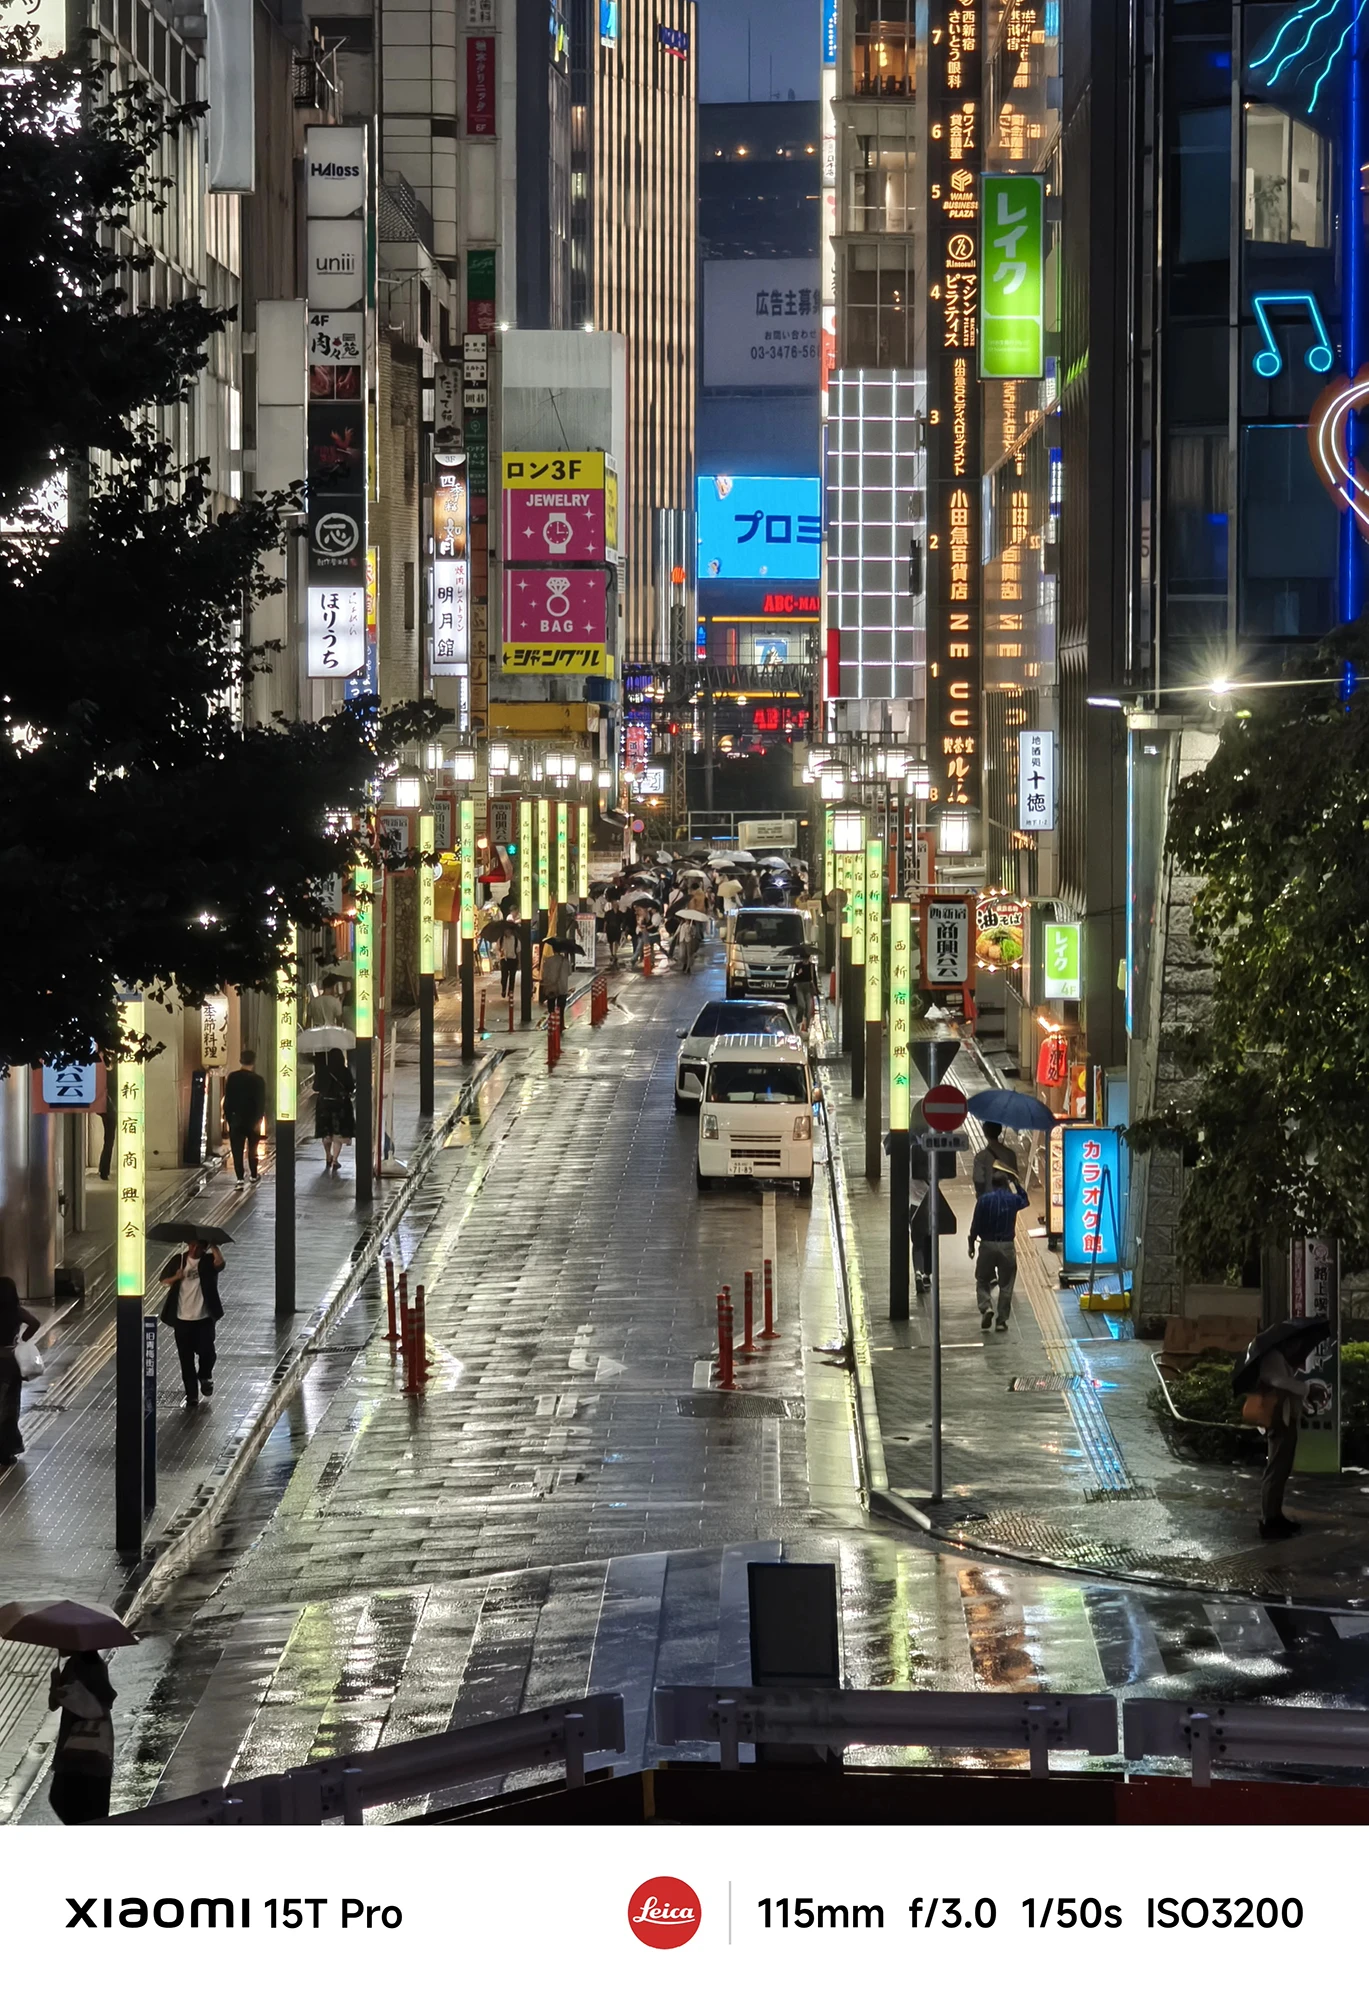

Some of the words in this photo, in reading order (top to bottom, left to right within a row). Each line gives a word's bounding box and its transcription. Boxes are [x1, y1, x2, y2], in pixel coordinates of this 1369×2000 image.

[932, 30, 942, 45] 7
[962, 10, 976, 50] 西新宿
[948, 10, 961, 88] さいとう眼科
[931, 124, 942, 139] 6
[963, 115, 975, 149] ワイム
[311, 163, 359, 177] HAloss
[931, 184, 941, 199] 5
[950, 192, 973, 201] WAIM
[949, 209, 974, 218] PLAZA
[993, 192, 1028, 295] レイク
[930, 285, 940, 299] 4
[962, 274, 977, 316] マシン
[310, 315, 329, 326] 4F
[944, 273, 961, 347] ピラティス
[930, 410, 940, 424] 3
[445, 455, 456, 463] 3F
[507, 459, 582, 480] ロン3F
[526, 494, 590, 507] JEWELRY
[734, 509, 820, 544] プロミ
[929, 535, 940, 550] 2
[950, 489, 969, 600] 小田急百貨店
[320, 593, 340, 669] ほりうち
[437, 586, 454, 657] 明月館
[540, 619, 574, 633] BAG
[513, 648, 600, 667] ジャングル
[931, 662, 939, 678] 1
[1027, 770, 1046, 813] 十徳
[929, 908, 967, 920] 西新宿
[976, 906, 1022, 930] 油そば
[936, 921, 958, 977] 商興会
[1054, 931, 1068, 971] レイク
[1061, 982, 1077, 995] 4F
[893, 940, 907, 1086] 西新宿商興会
[203, 1005, 218, 1059] 季節料理
[120, 1081, 141, 1239] 新宿商興会
[1082, 1140, 1103, 1253] カラオケ館
